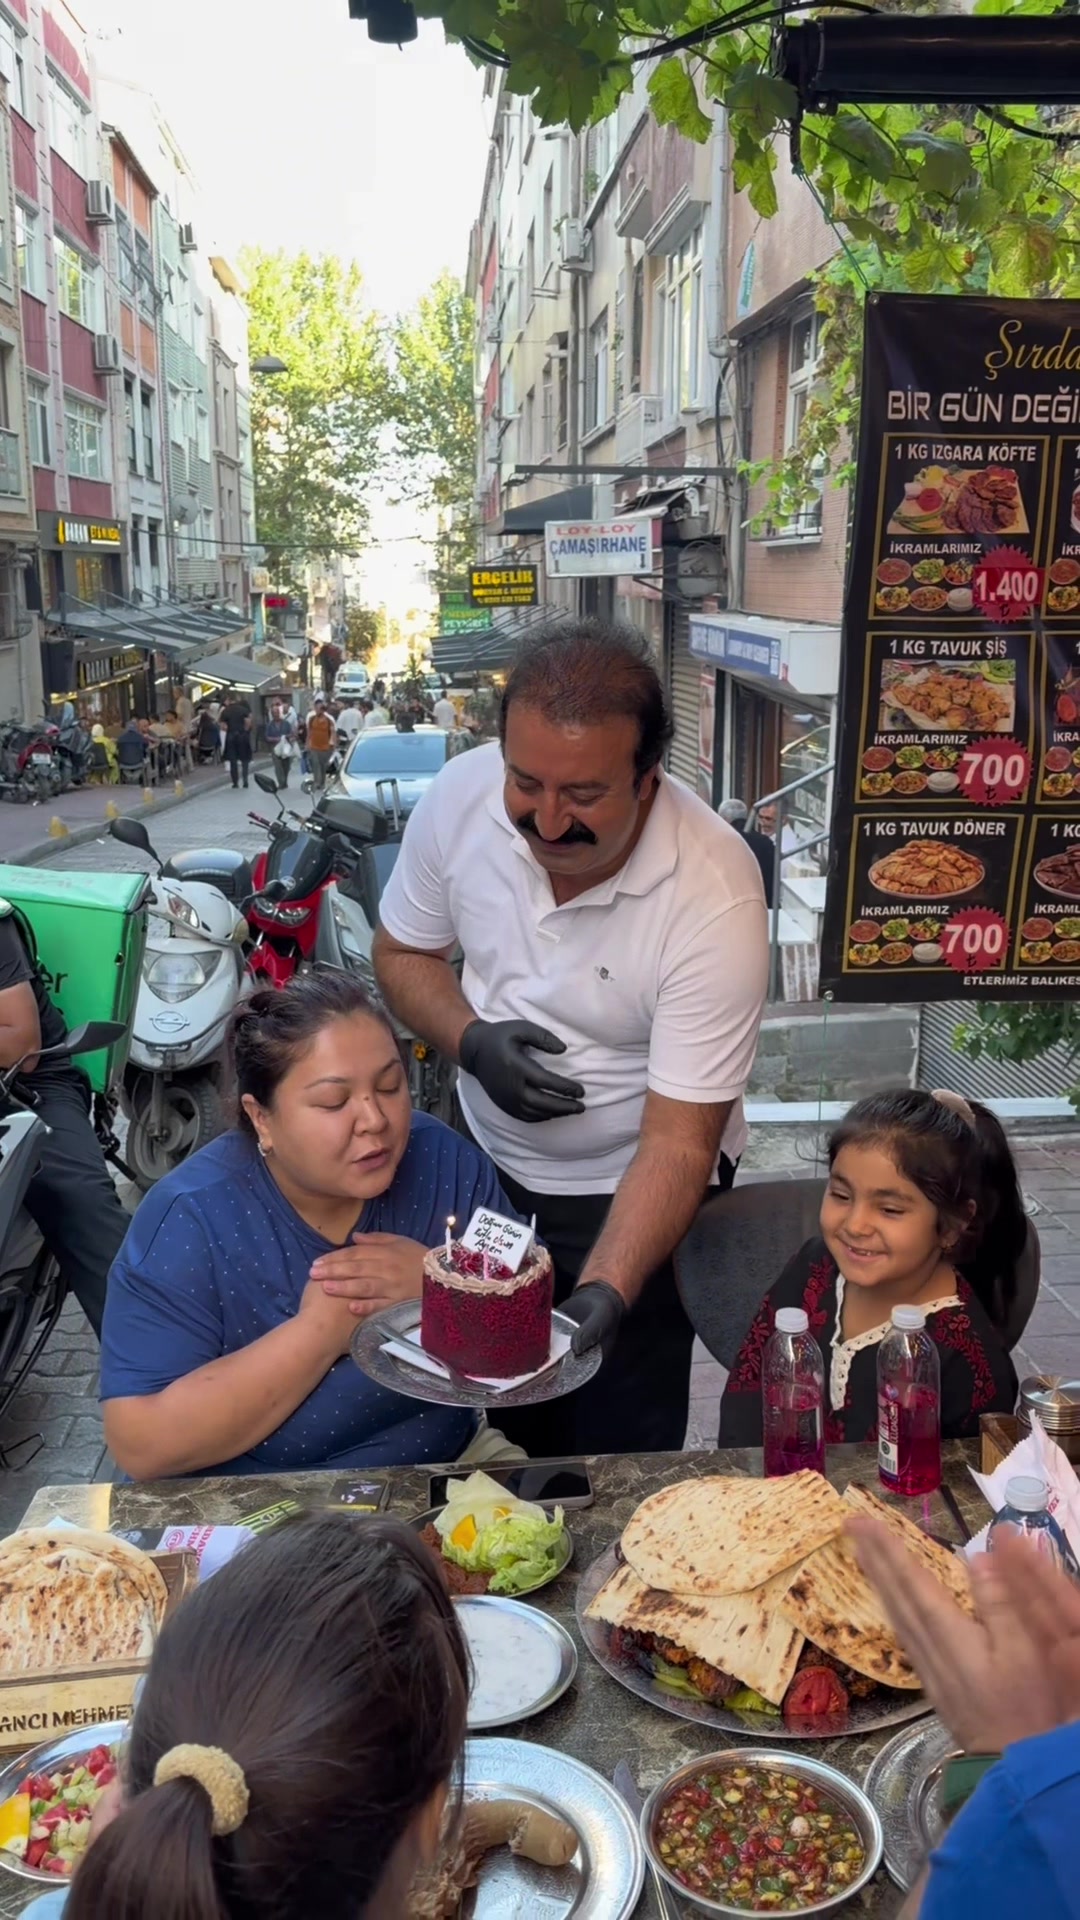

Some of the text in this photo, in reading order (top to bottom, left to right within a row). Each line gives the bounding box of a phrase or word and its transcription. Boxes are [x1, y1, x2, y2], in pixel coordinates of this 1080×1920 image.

[887, 384, 931, 421] BİR
[939, 386, 1003, 423] GÜN
[895, 443, 1037, 462] 1 KG IZGARA KÖFTE
[549, 536, 647, 559] ÇAMAŞIRHANE
[889, 541, 982, 555] İKRAMLARIMIZ
[976, 570, 1039, 602] 1.400
[889, 636, 1007, 659] 1 KG TAVUK ŞİŞ
[874, 733, 968, 745] İKRAMLARIMIZ
[962, 753, 1025, 787] 700
[863, 818, 1006, 836] 1 KG TAVUK DÖNER
[1051, 823, 1058, 837] 1
[861, 905, 950, 916] İKRAMLARIMIZ
[944, 923, 1003, 954] 700
[963, 974, 1028, 986] ETLERİMİZ
